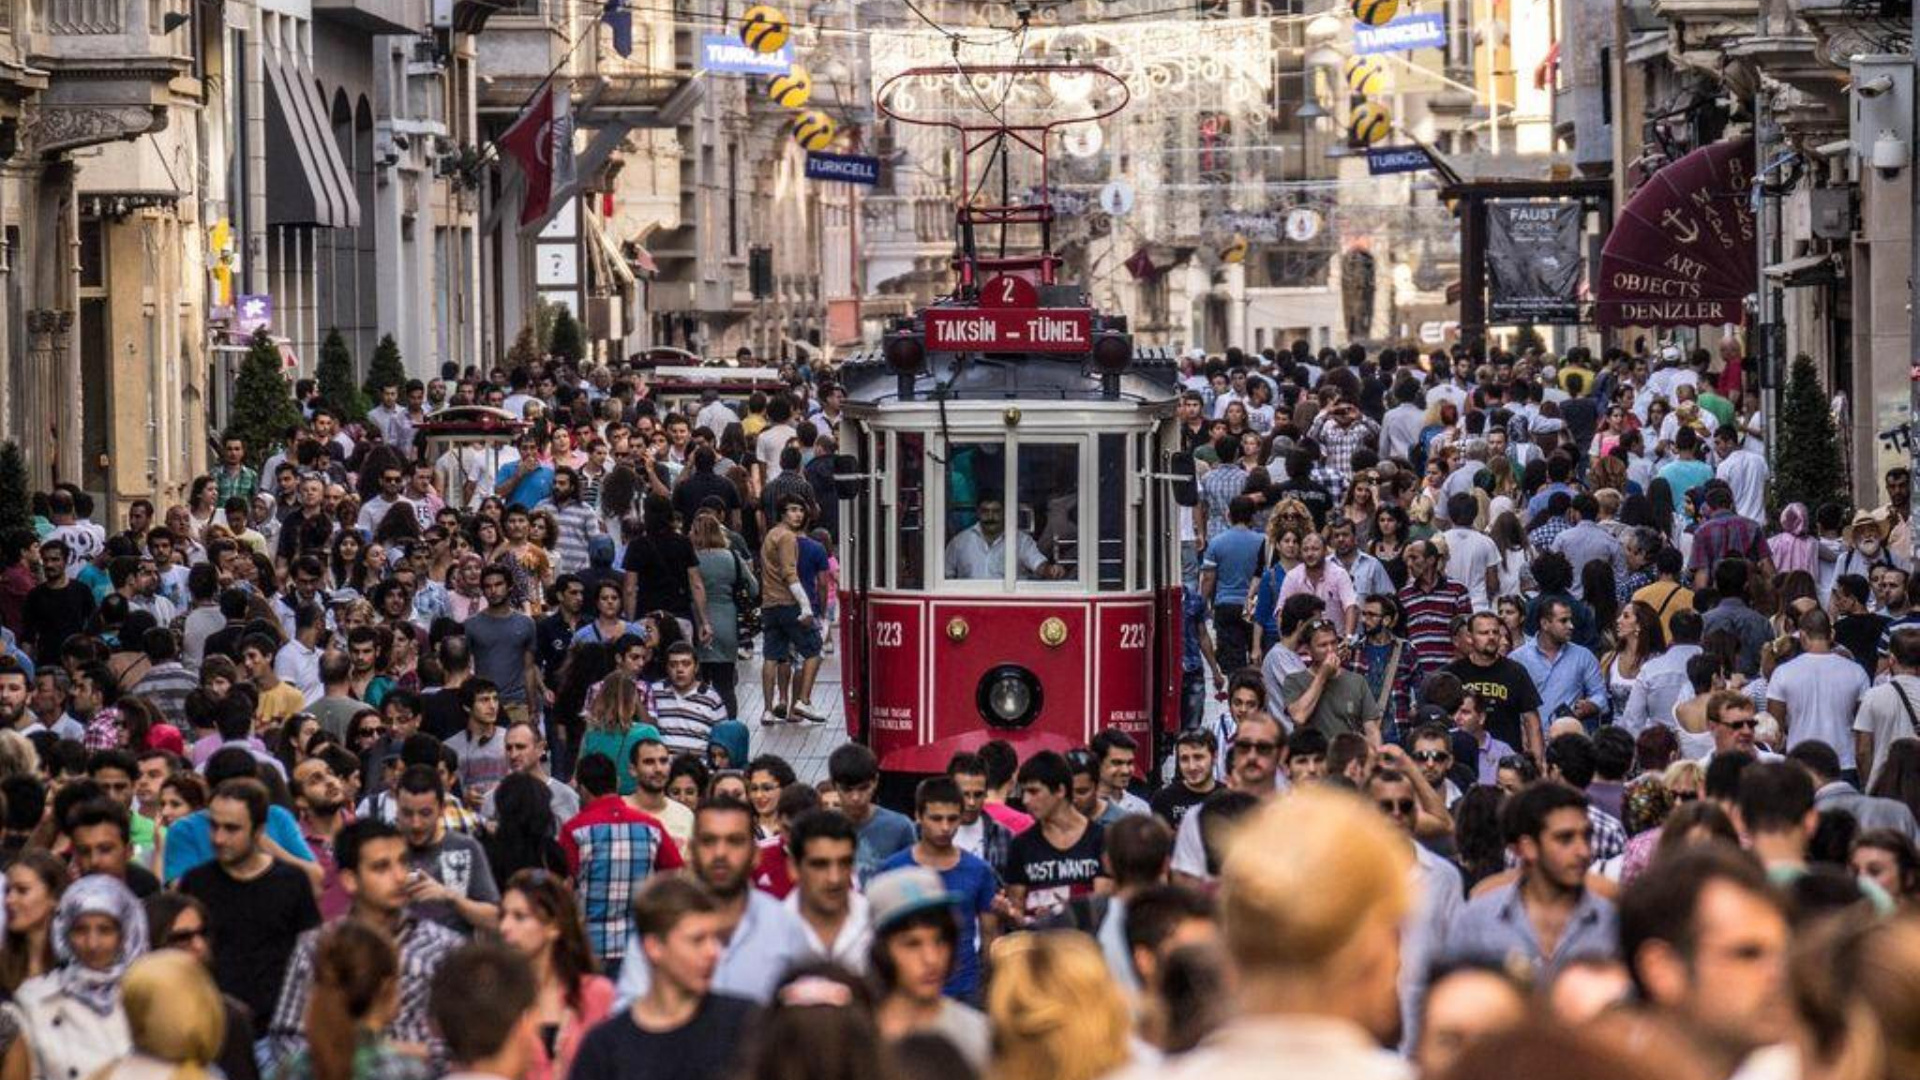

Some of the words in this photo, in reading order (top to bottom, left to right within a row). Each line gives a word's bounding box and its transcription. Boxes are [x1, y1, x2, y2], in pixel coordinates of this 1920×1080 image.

[809, 158, 876, 178] TURKCELL
[1728, 157, 1754, 241] BOOKS
[1510, 207, 1560, 221] FAUST
[1691, 186, 1734, 249] MAPS
[1663, 253, 1708, 280] ART
[1001, 277, 1015, 303] 2
[1613, 271, 1701, 299] OBJECTS
[1621, 301, 1725, 320] DENİZLER
[1026, 316, 1085, 343] TÜNEL
[876, 621, 903, 647] 223
[1120, 623, 1147, 649] 223
